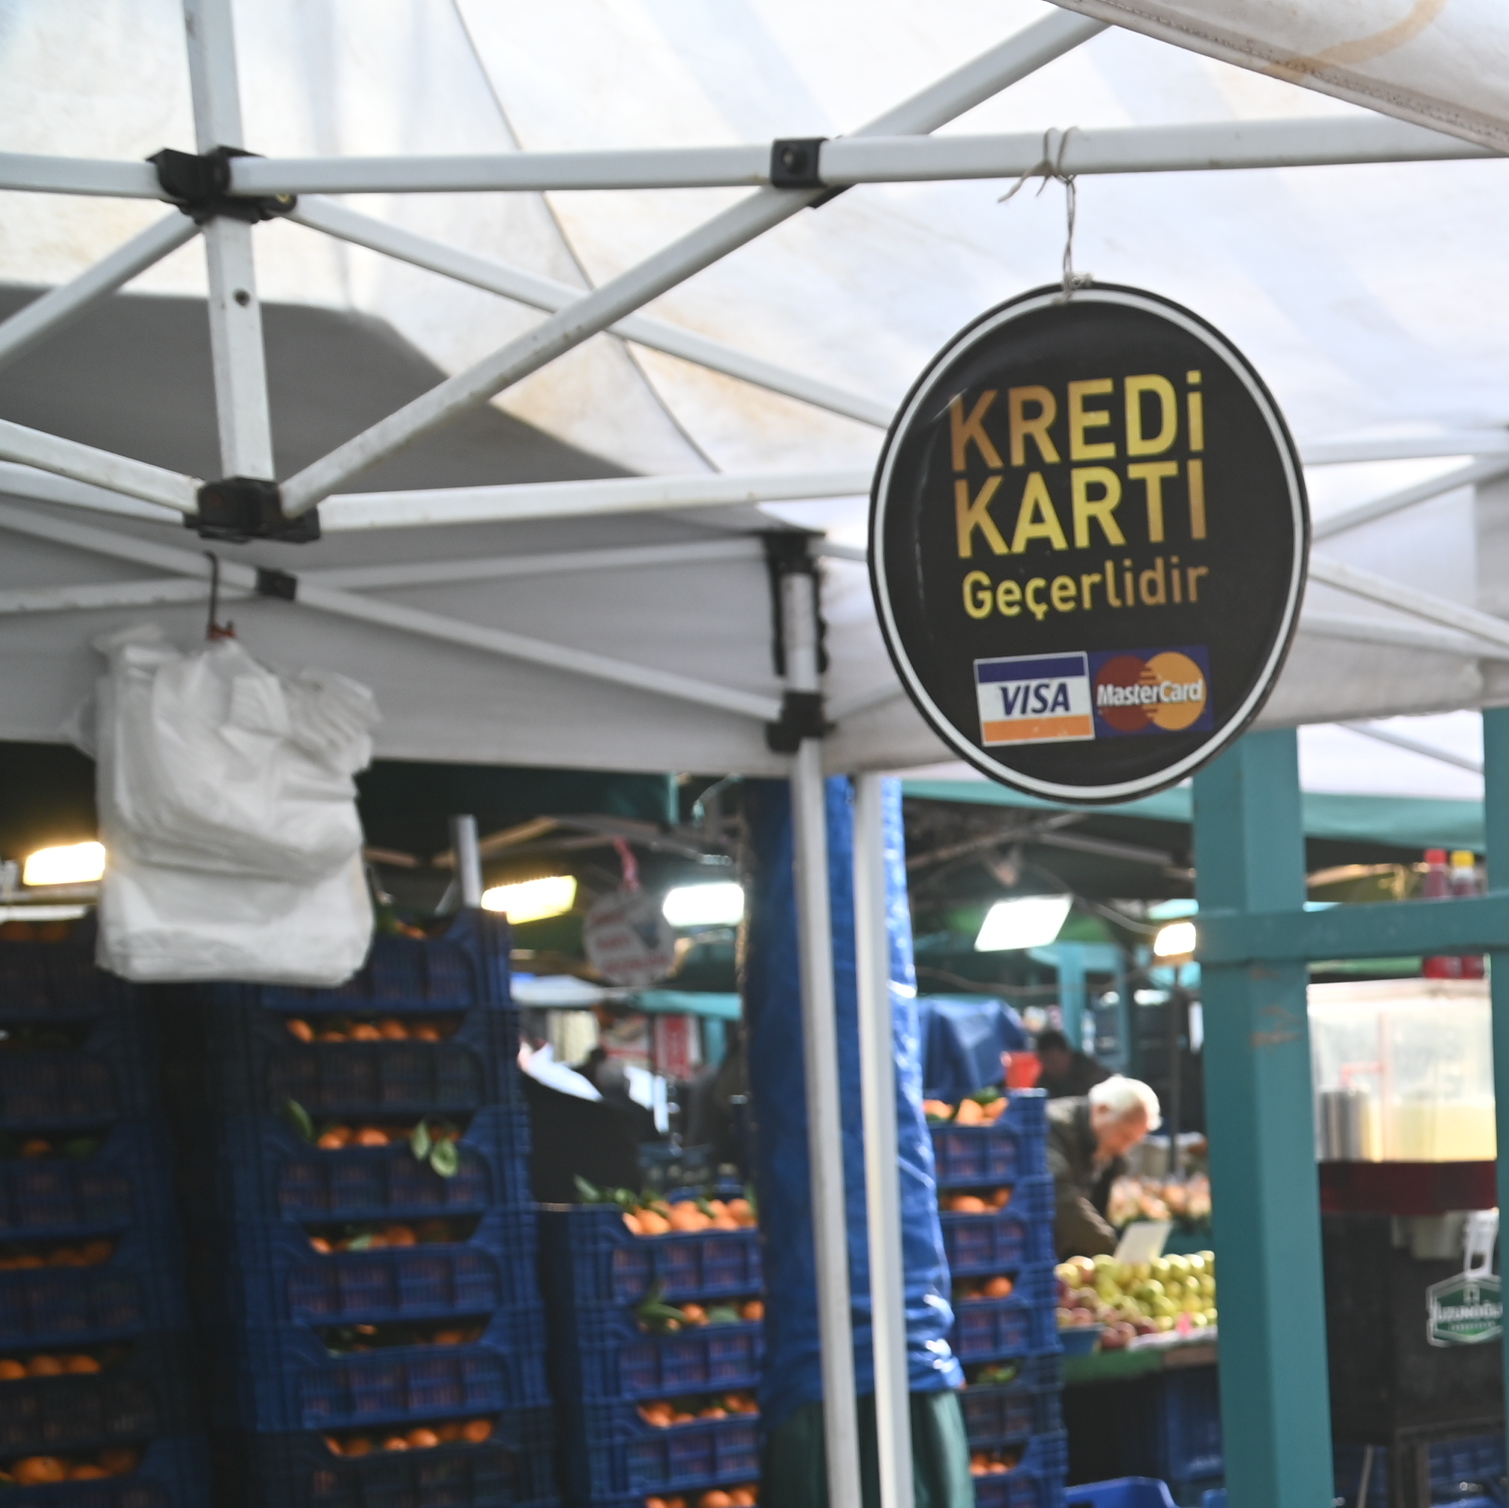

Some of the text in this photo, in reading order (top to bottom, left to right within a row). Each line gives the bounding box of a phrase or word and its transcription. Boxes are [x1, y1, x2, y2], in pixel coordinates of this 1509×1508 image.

[954, 458, 1207, 558] KARTI
[962, 555, 1209, 620] Geçerlidir
[1000, 681, 1071, 716] VISA
[1097, 678, 1205, 707] MasterCard
